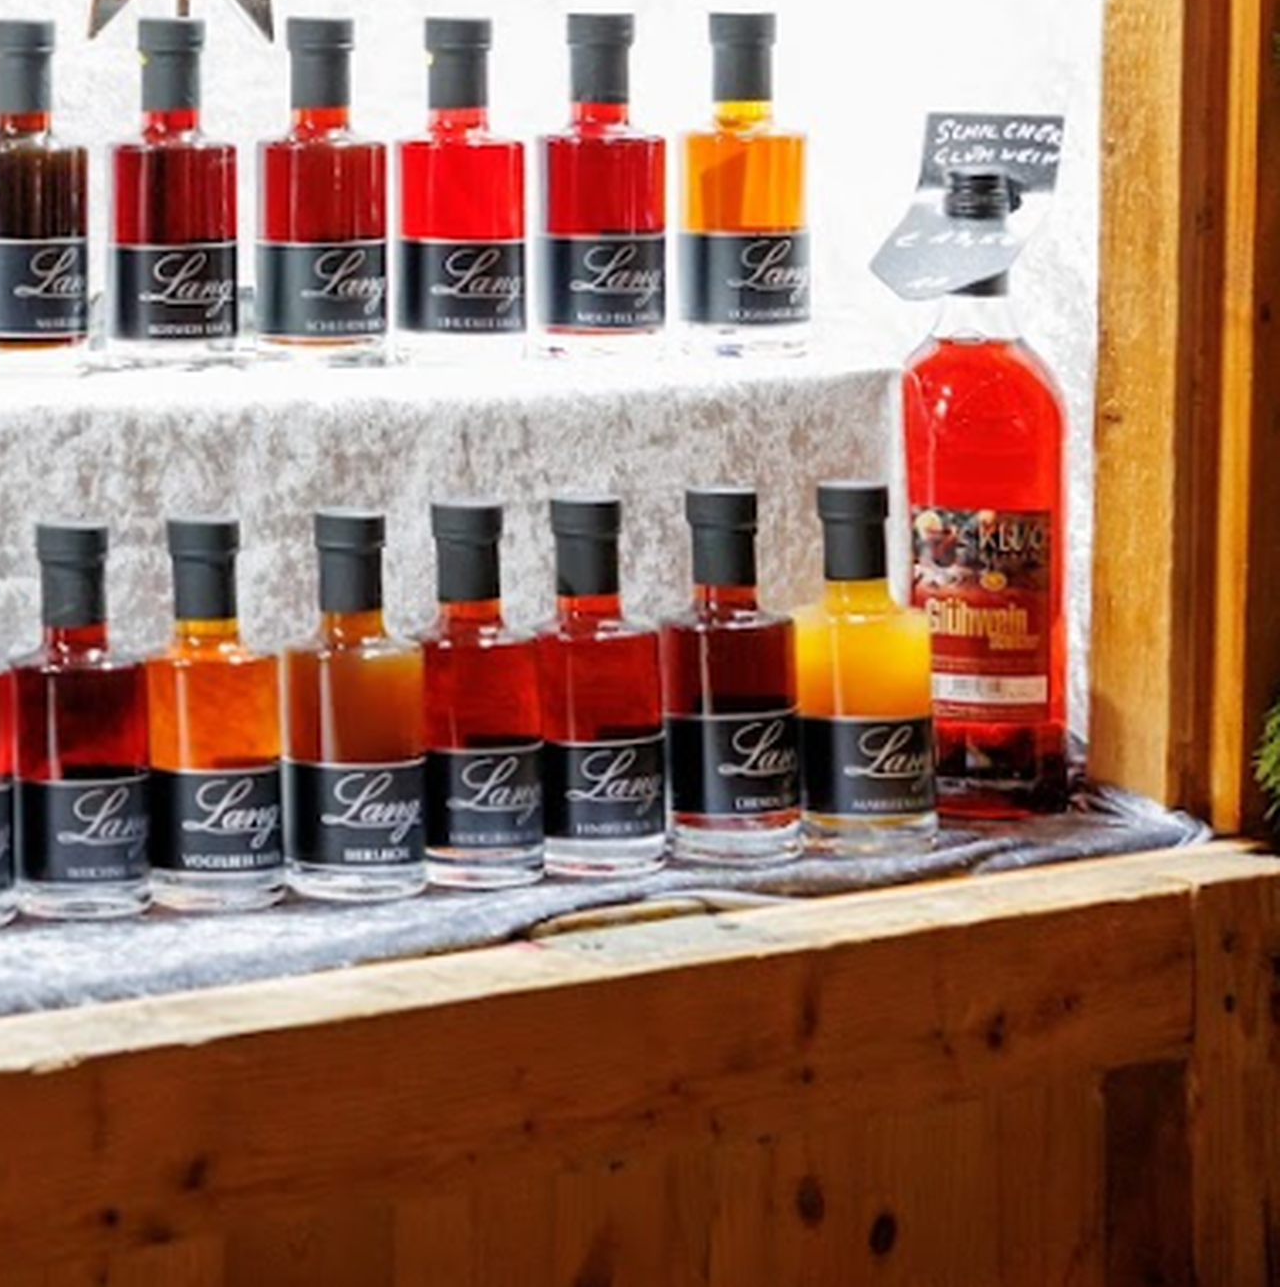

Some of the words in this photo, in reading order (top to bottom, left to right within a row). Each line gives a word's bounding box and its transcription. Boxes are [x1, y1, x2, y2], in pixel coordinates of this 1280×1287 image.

[137, 252, 233, 318] Lang
[301, 249, 386, 315] Lang
[430, 248, 523, 313] Lang
[570, 243, 661, 309] Lang
[726, 239, 810, 305] Lang
[446, 756, 542, 826] Lang
[564, 747, 661, 816] Lang
[842, 725, 933, 793] Lang
[56, 786, 150, 858] Lang
[181, 777, 280, 849] Lang
[321, 772, 423, 845] Lang
